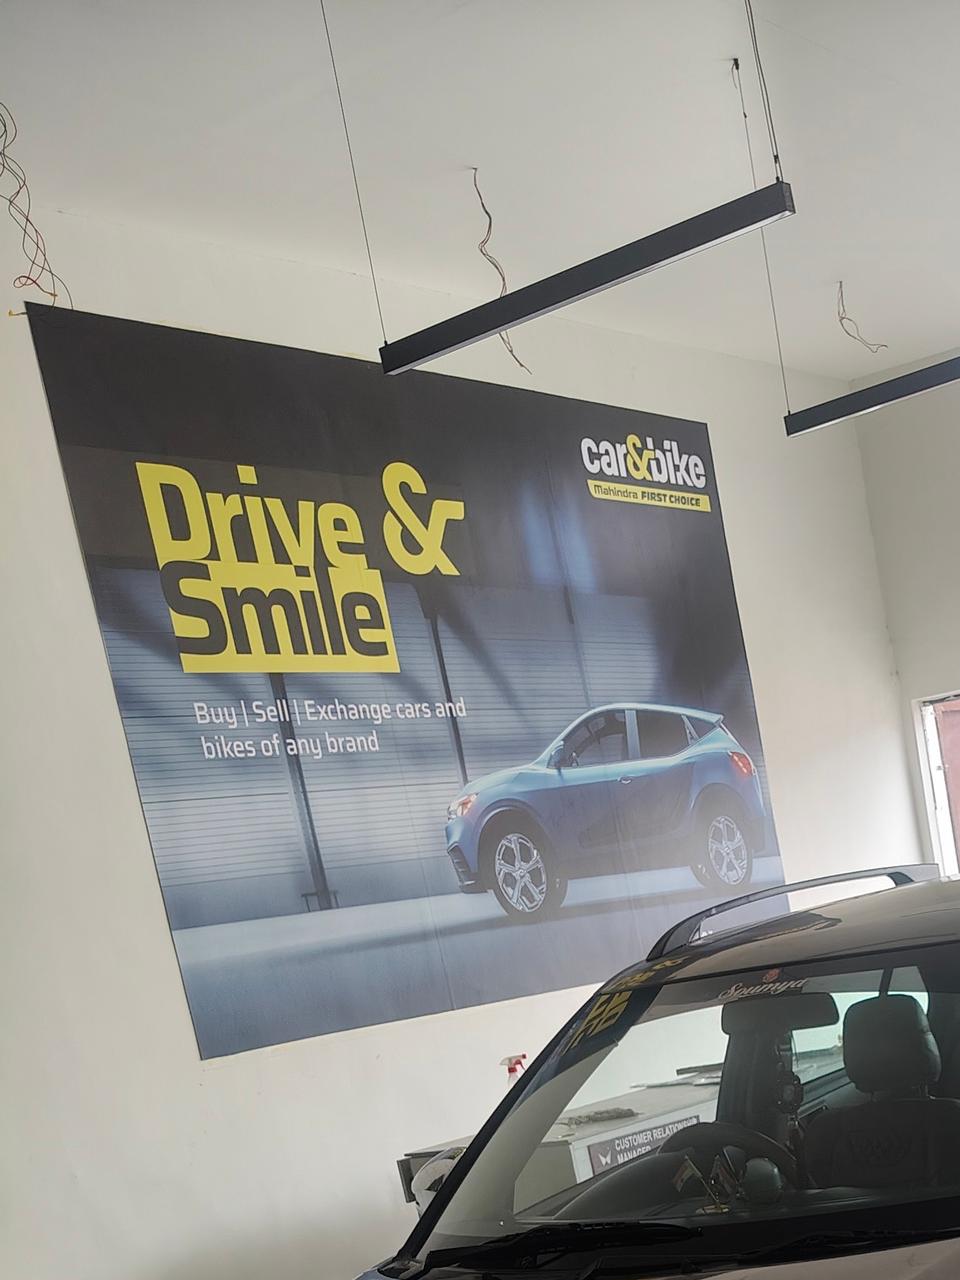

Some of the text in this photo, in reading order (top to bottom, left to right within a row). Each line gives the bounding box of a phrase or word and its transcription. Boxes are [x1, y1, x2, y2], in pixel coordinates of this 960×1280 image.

[580, 433, 706, 489] car&bike
[641, 491, 667, 503] FIRST
[669, 494, 701, 507] CHOICE
[135, 461, 465, 576] Drive &
[159, 559, 390, 657] Smile
[193, 702, 237, 728] Buy
[253, 699, 290, 723] Sell
[303, 697, 392, 724] Exchange
[396, 700, 432, 719] cars
[435, 697, 467, 718] and
[200, 730, 380, 759] bikes of any brand
[615, 1130, 653, 1151] CUSTOMER
